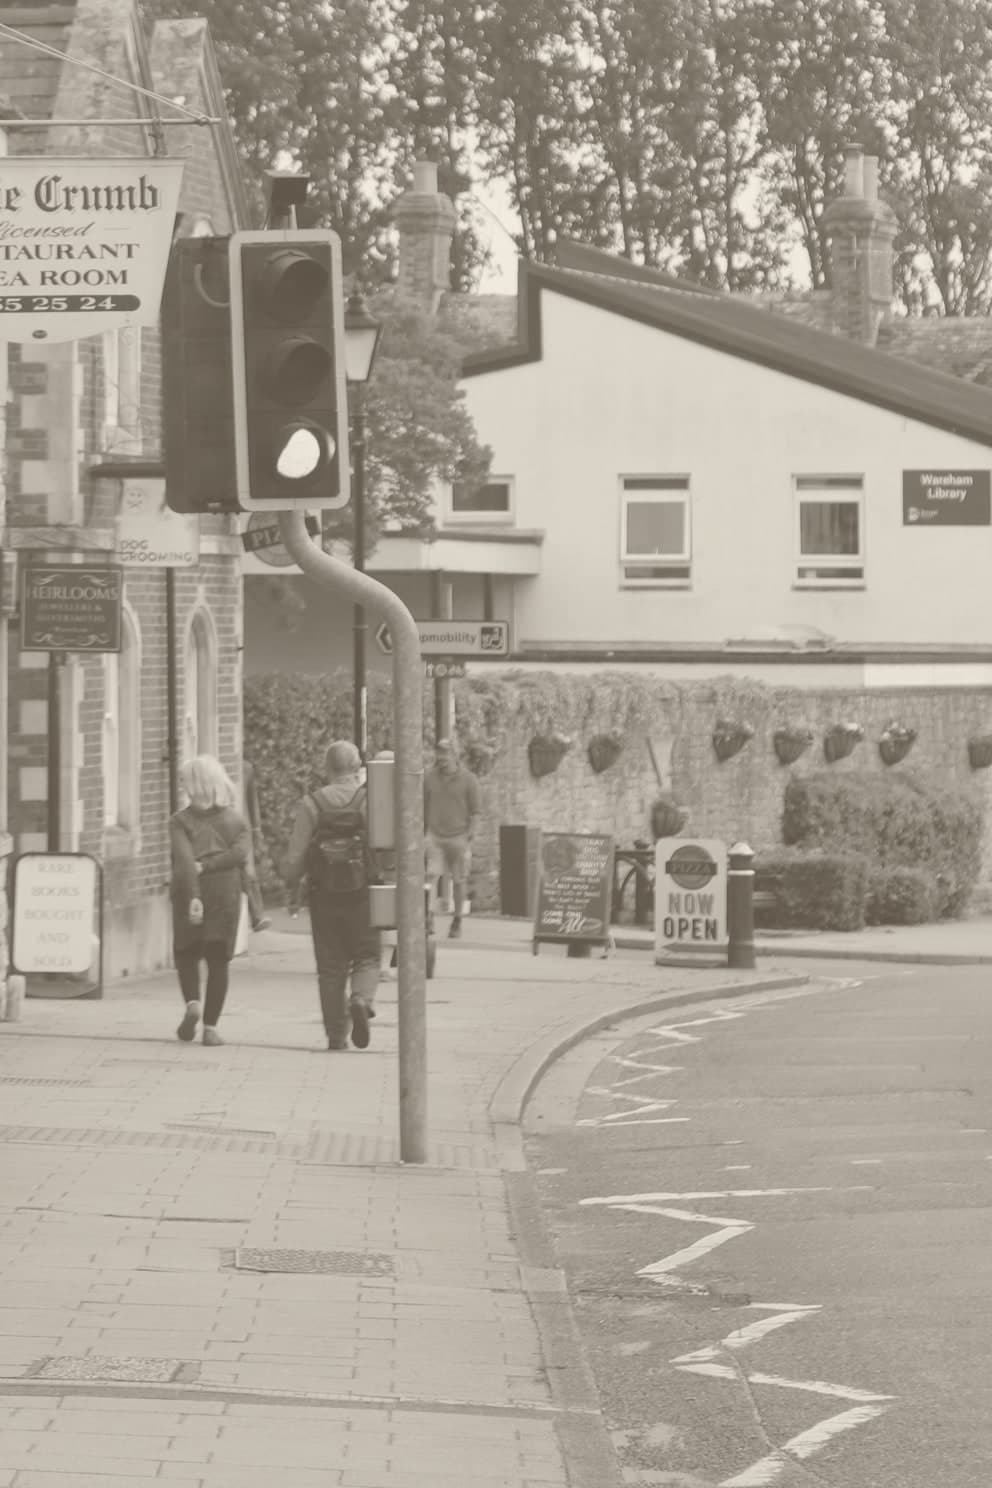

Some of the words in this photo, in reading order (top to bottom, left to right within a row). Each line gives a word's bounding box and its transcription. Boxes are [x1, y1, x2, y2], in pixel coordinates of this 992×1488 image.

[34, 174, 160, 214] Crumb
[40, 269, 128, 286] ROOM
[32, 297, 68, 311] 25
[80, 296, 116, 310] 24
[920, 474, 974, 486] Wareham
[927, 487, 968, 502] Library
[120, 540, 148, 550] DOG
[119, 552, 193, 562] GROOMING
[27, 585, 120, 601] HEIRLOOMS
[419, 631, 478, 644] pmobility
[38, 863, 73, 873] RARE
[671, 862, 712, 873] PIZZA
[31, 887, 80, 897] BOOKS
[668, 893, 714, 915] NOW
[24, 910, 84, 920] BOUGHT
[664, 916, 718, 941] OPEN
[38, 933, 70, 944] AND
